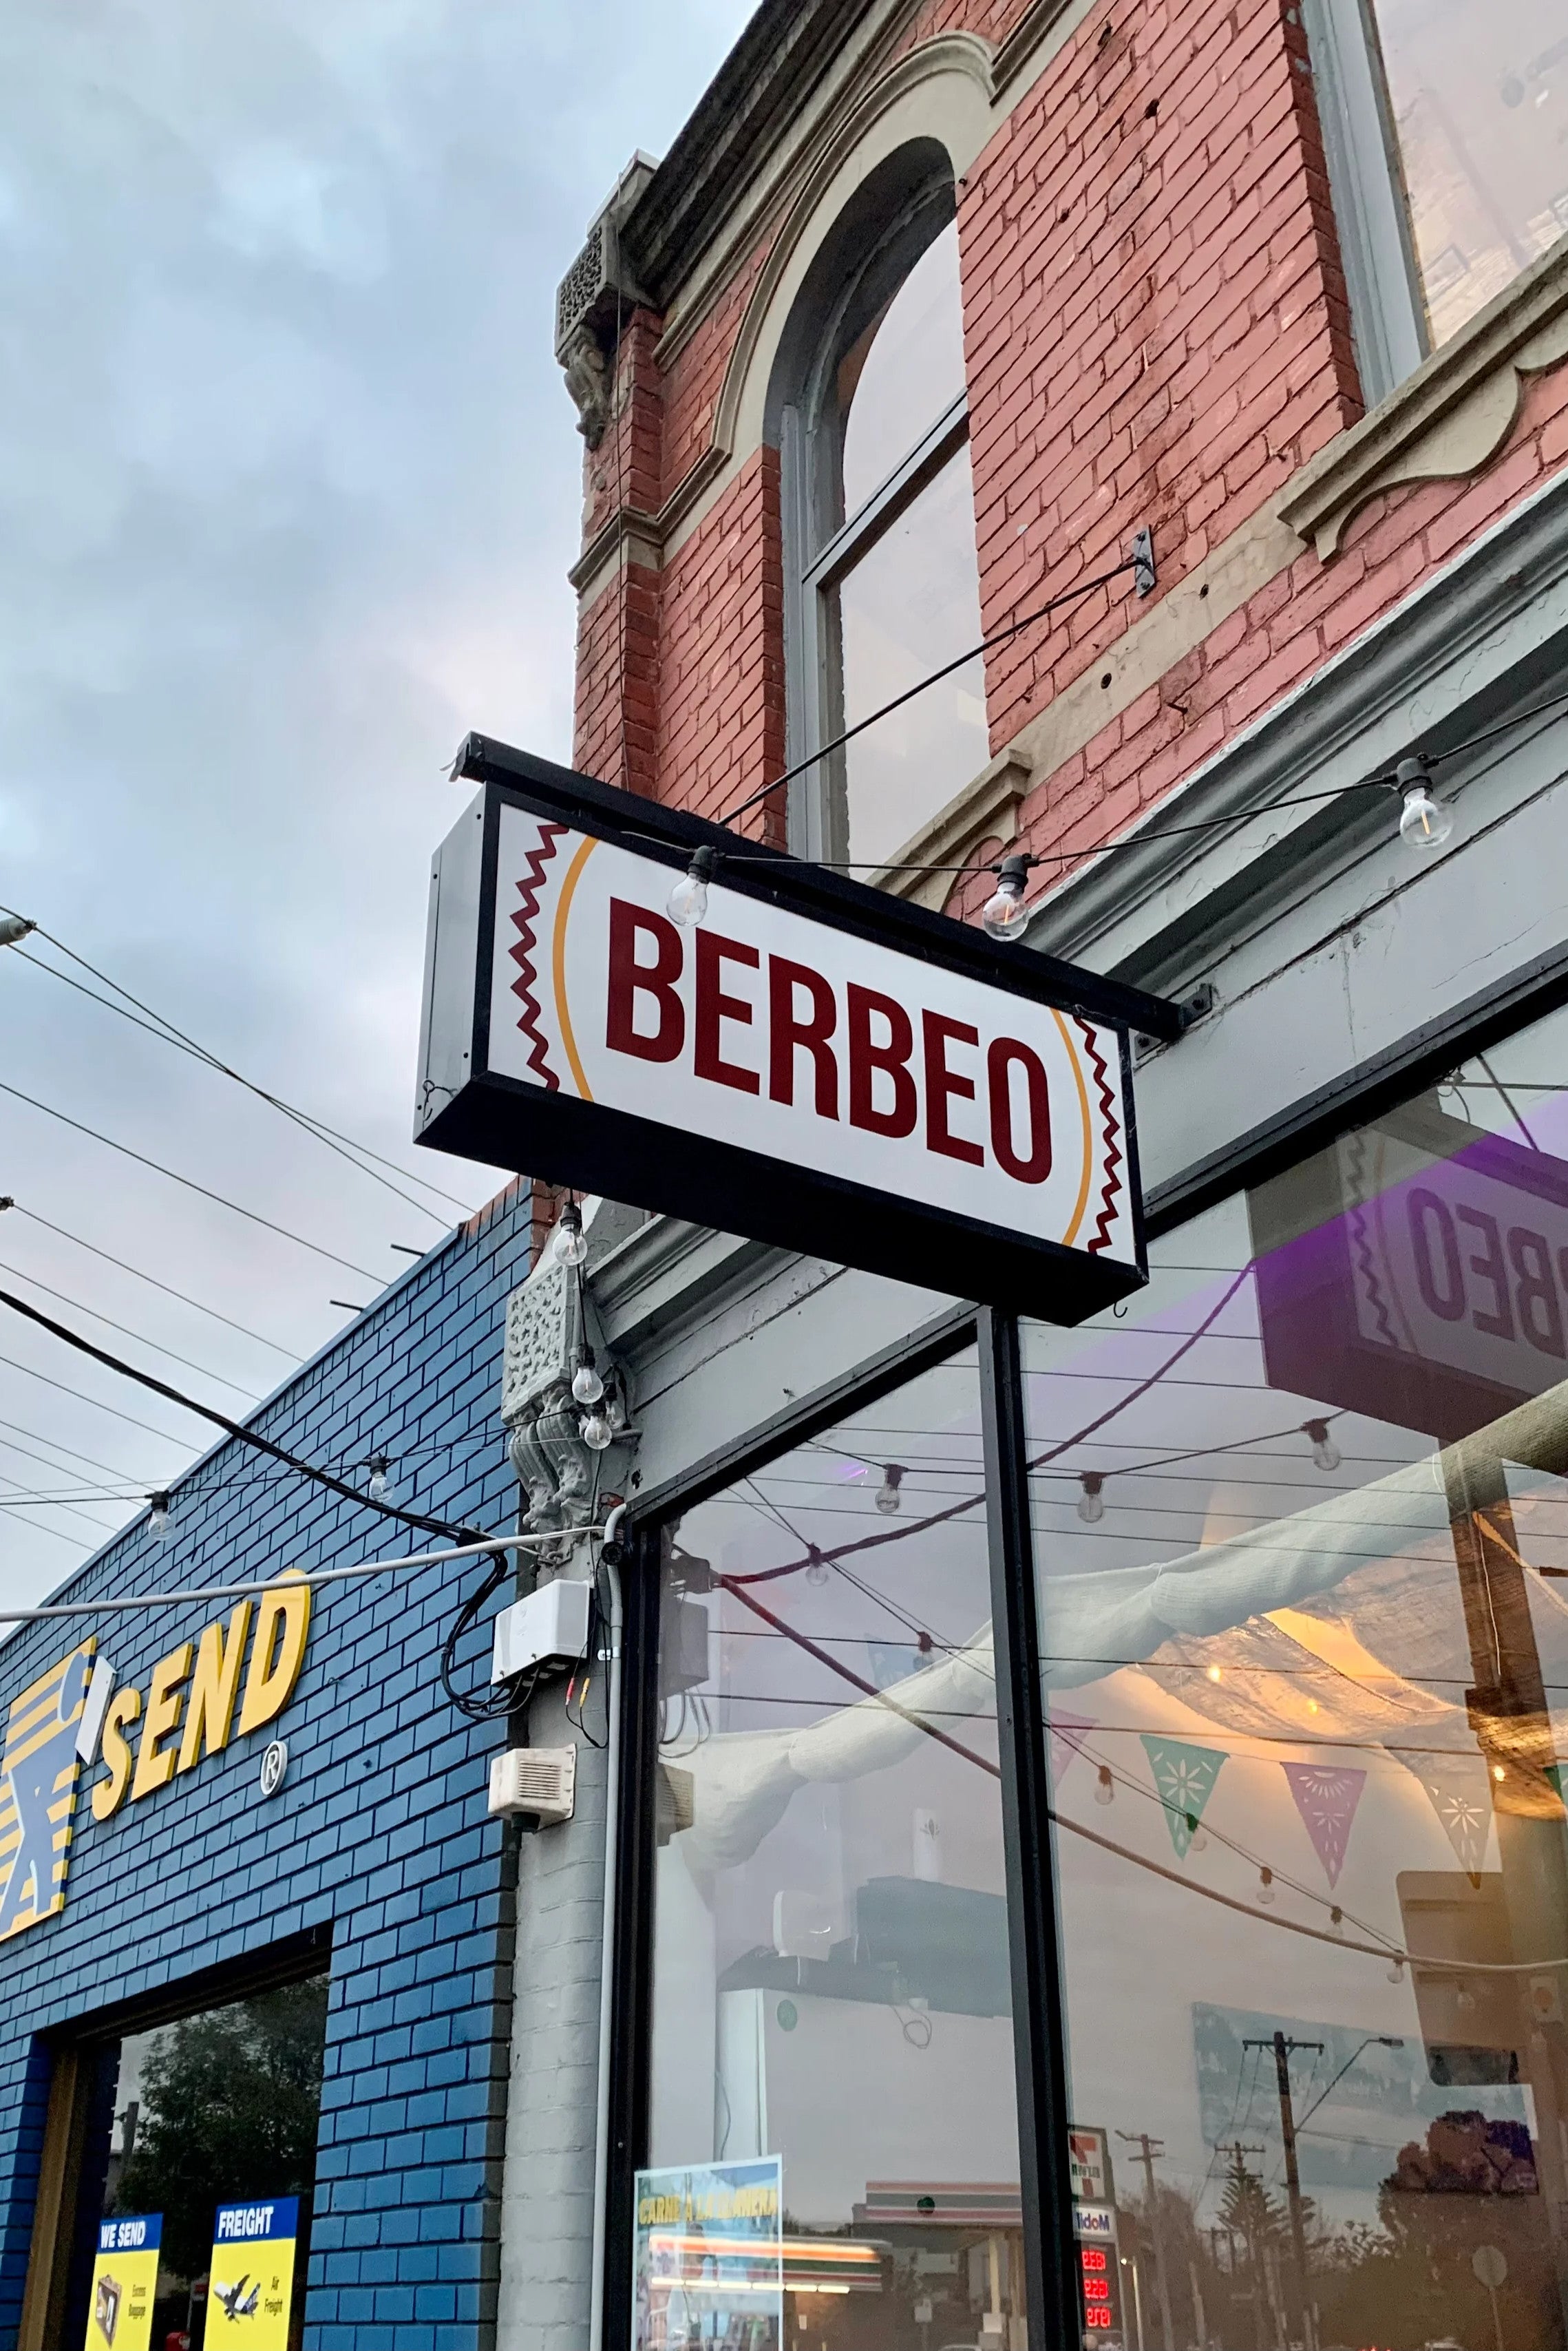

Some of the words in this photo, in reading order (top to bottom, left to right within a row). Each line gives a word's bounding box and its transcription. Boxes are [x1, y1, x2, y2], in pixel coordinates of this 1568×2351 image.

[606, 896, 1052, 1184] BERBEO
[92, 1568, 310, 1821] SEND
[100, 2224, 116, 2249] WE
[118, 2220, 147, 2247] SEND
[218, 2206, 275, 2238] FREIGHT
[264, 2297, 283, 2317] Freight
